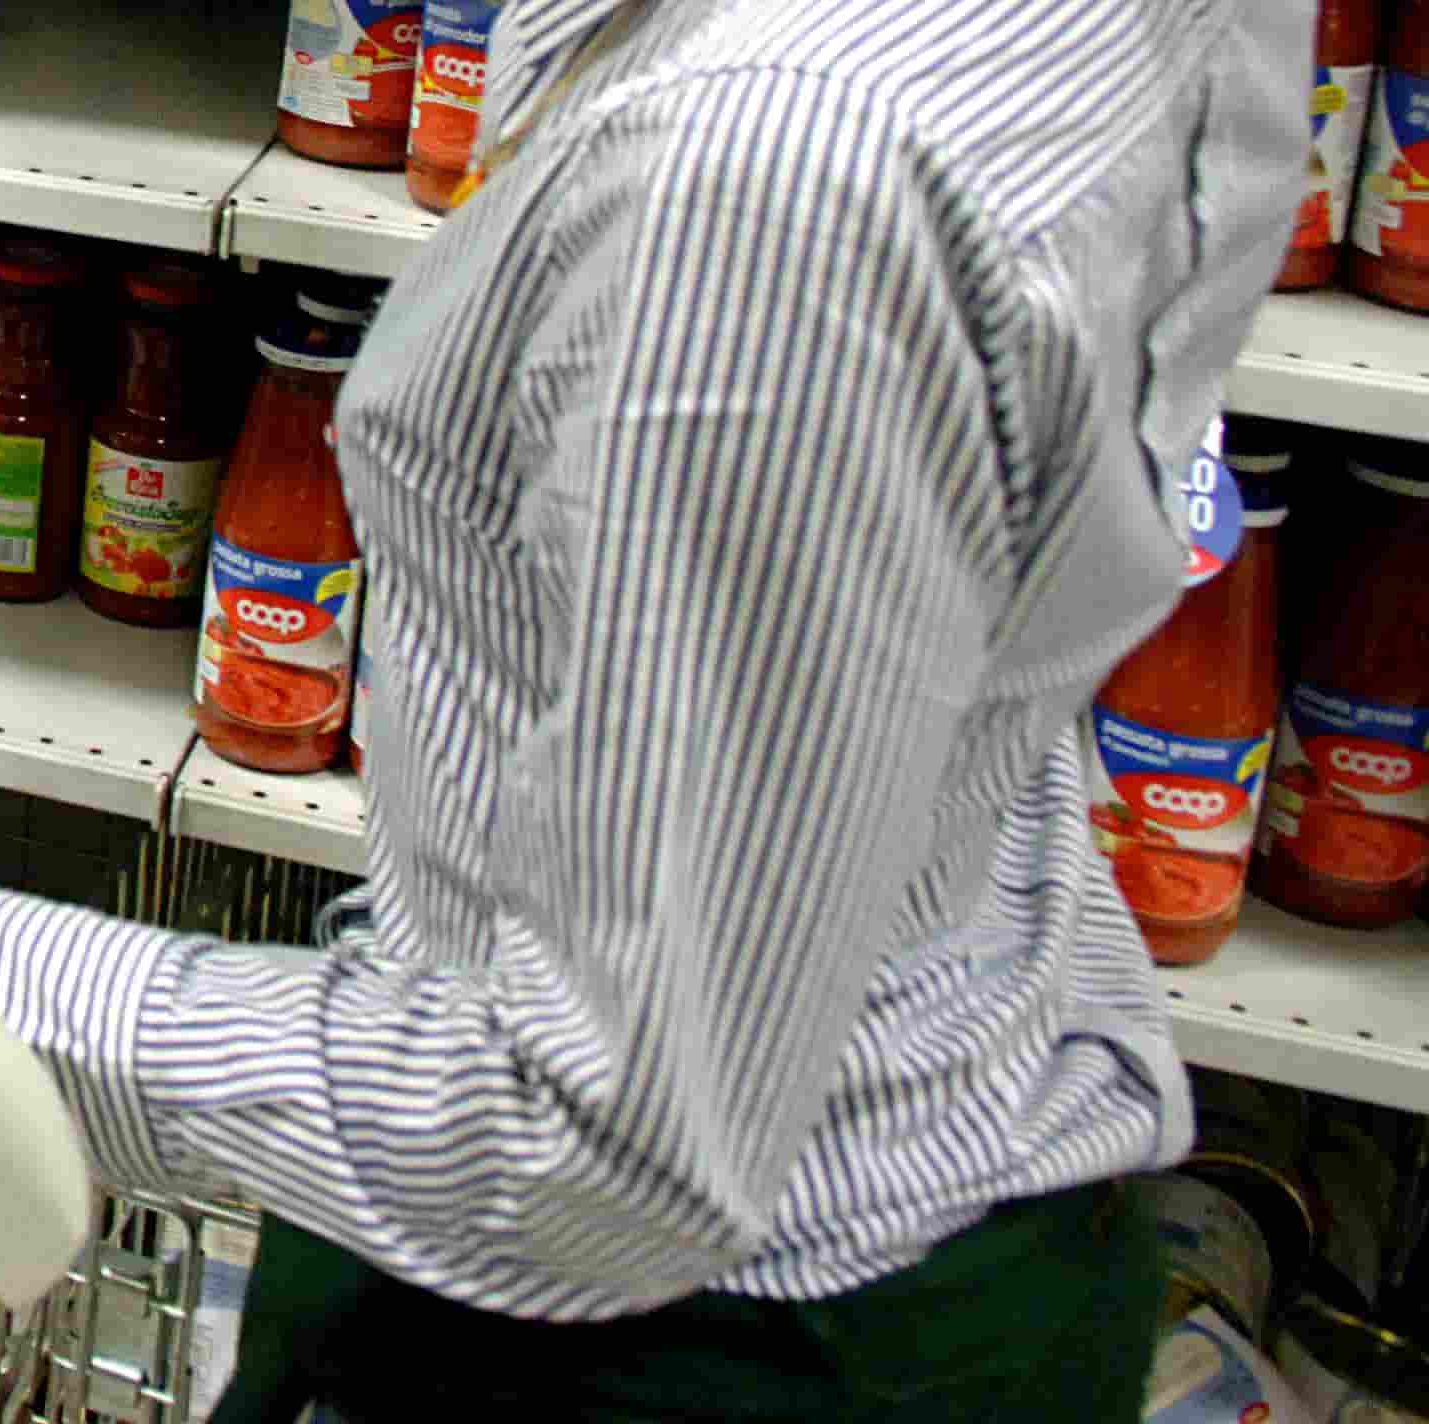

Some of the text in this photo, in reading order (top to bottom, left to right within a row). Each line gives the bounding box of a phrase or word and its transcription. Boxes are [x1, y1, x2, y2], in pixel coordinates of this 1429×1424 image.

[237, 598, 306, 636] coop
[1330, 746, 1413, 785] coop
[1143, 784, 1228, 822] coop
